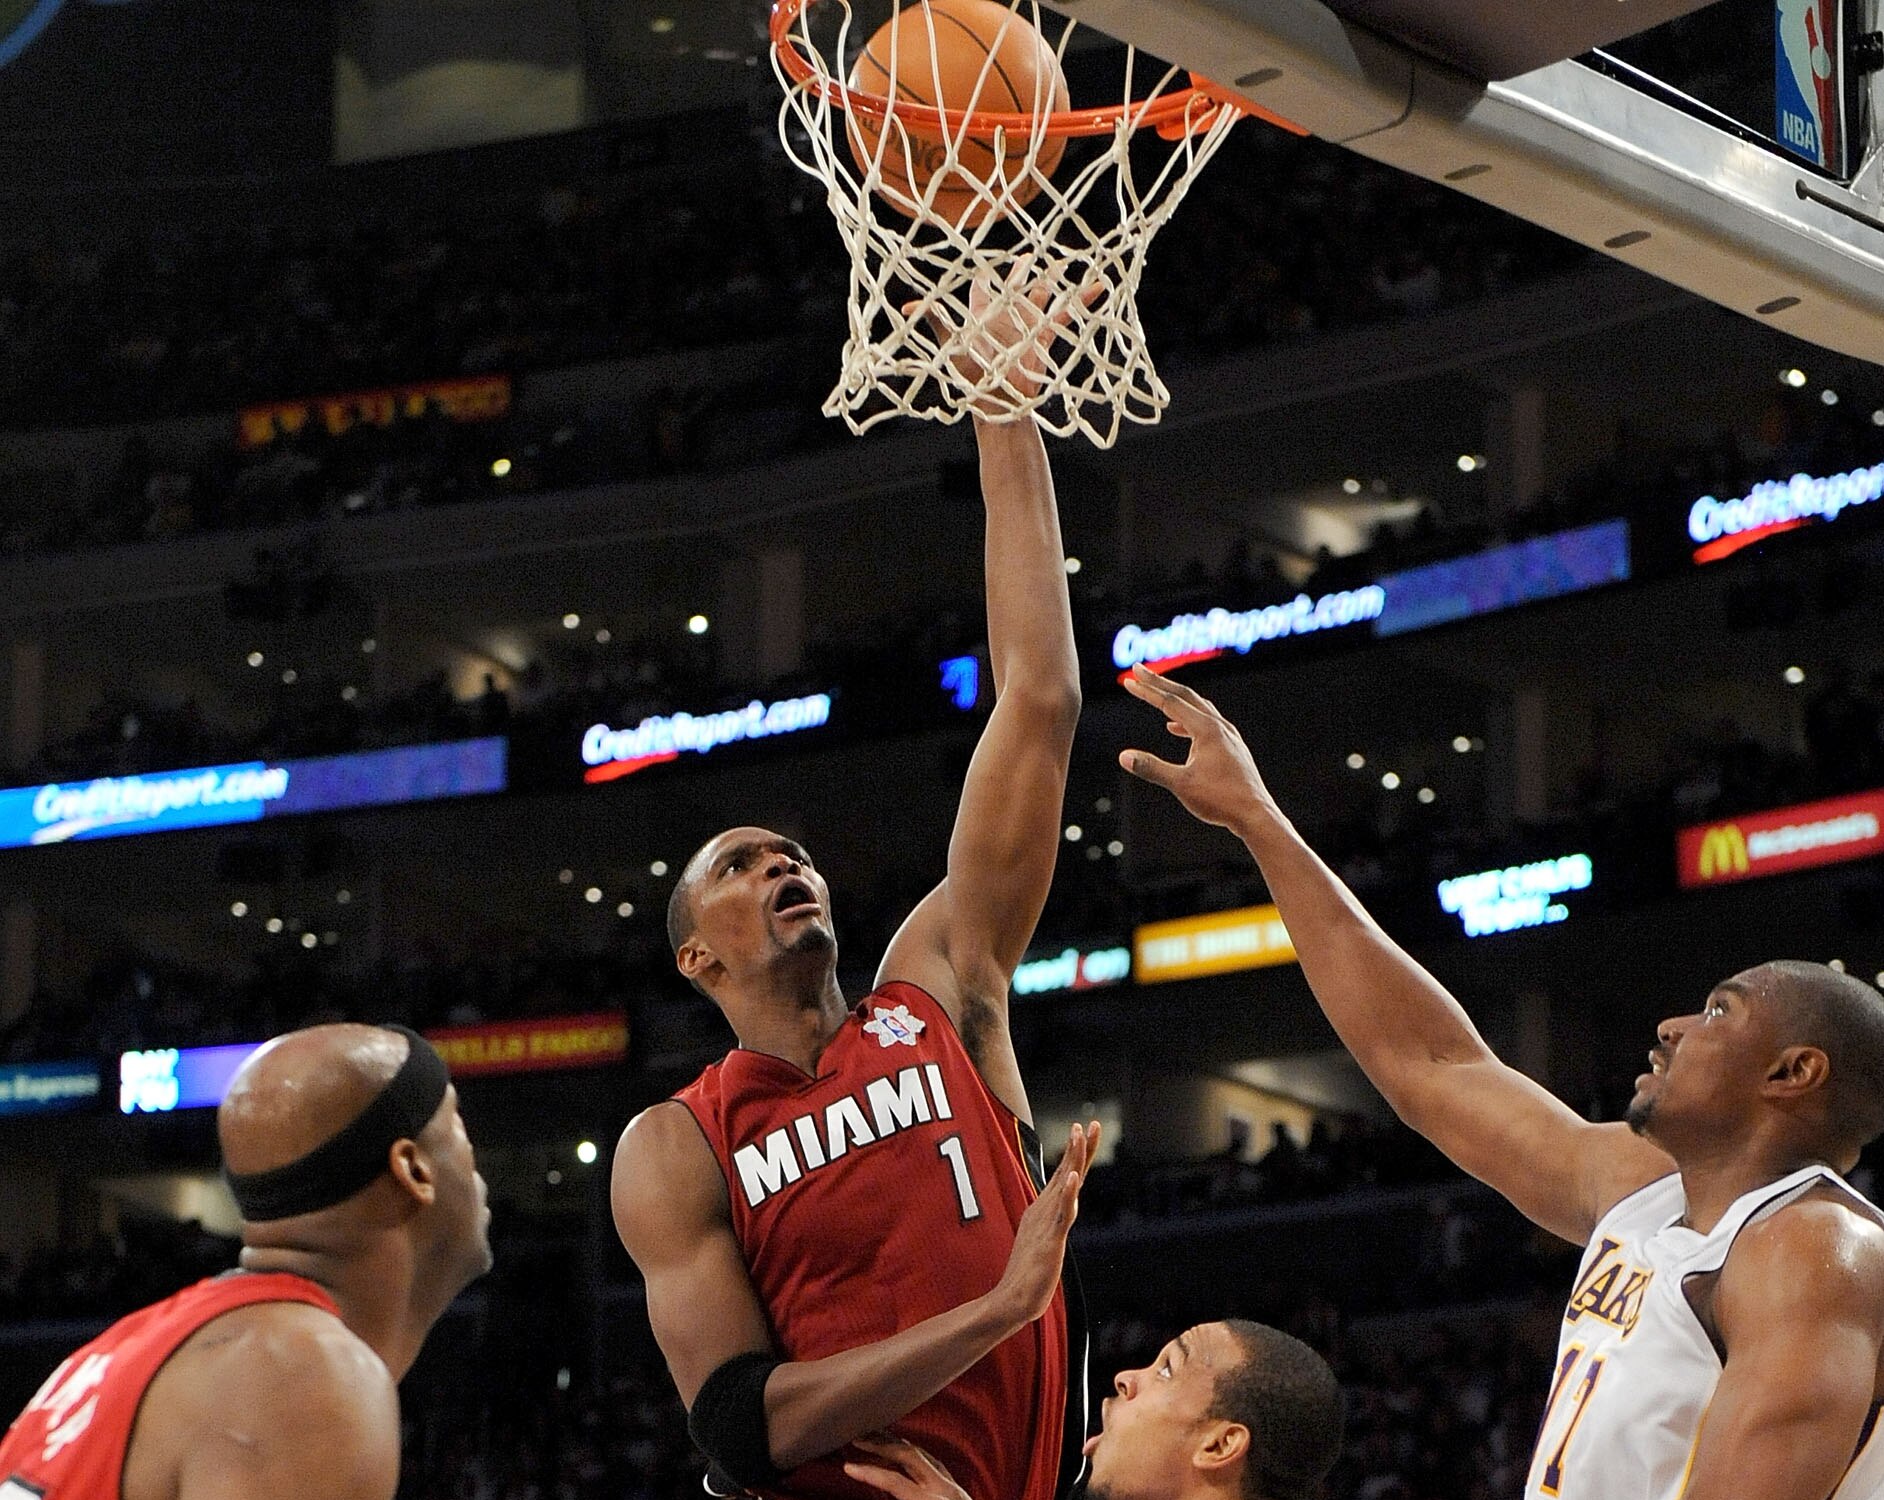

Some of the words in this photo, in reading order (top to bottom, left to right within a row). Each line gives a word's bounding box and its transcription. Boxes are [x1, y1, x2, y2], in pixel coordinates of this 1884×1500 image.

[1783, 109, 1816, 154] NBA
[733, 1062, 954, 1208] MIAMI
[938, 1134, 981, 1221] 1
